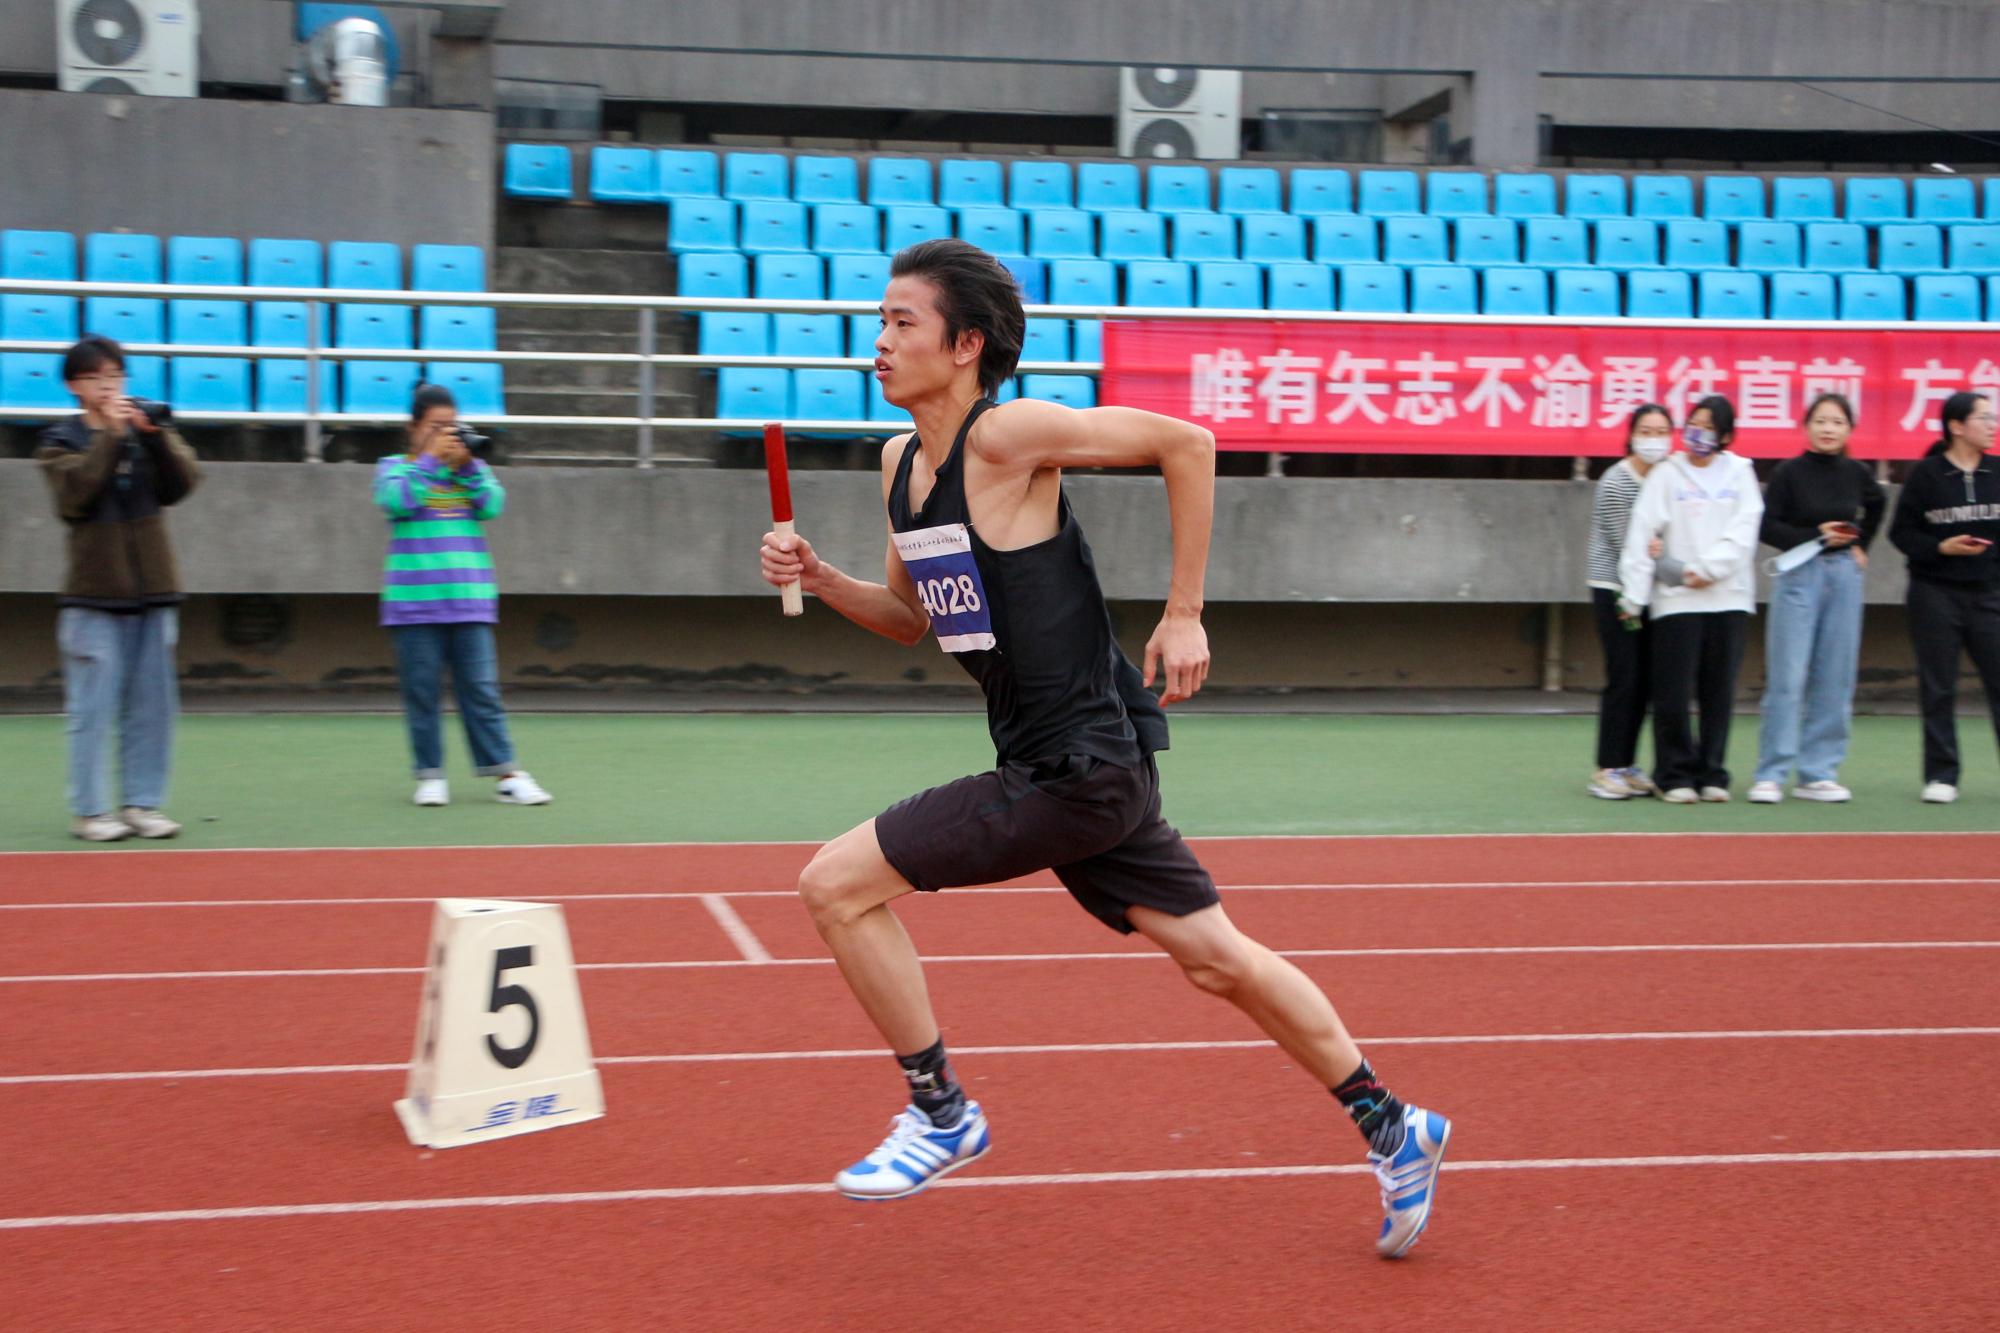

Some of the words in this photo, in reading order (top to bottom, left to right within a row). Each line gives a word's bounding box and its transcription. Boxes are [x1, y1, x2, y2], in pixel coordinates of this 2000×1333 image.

[1190, 348, 1865, 428] 唯有矢志不渝勇往直前
[485, 945, 541, 1069] 5
